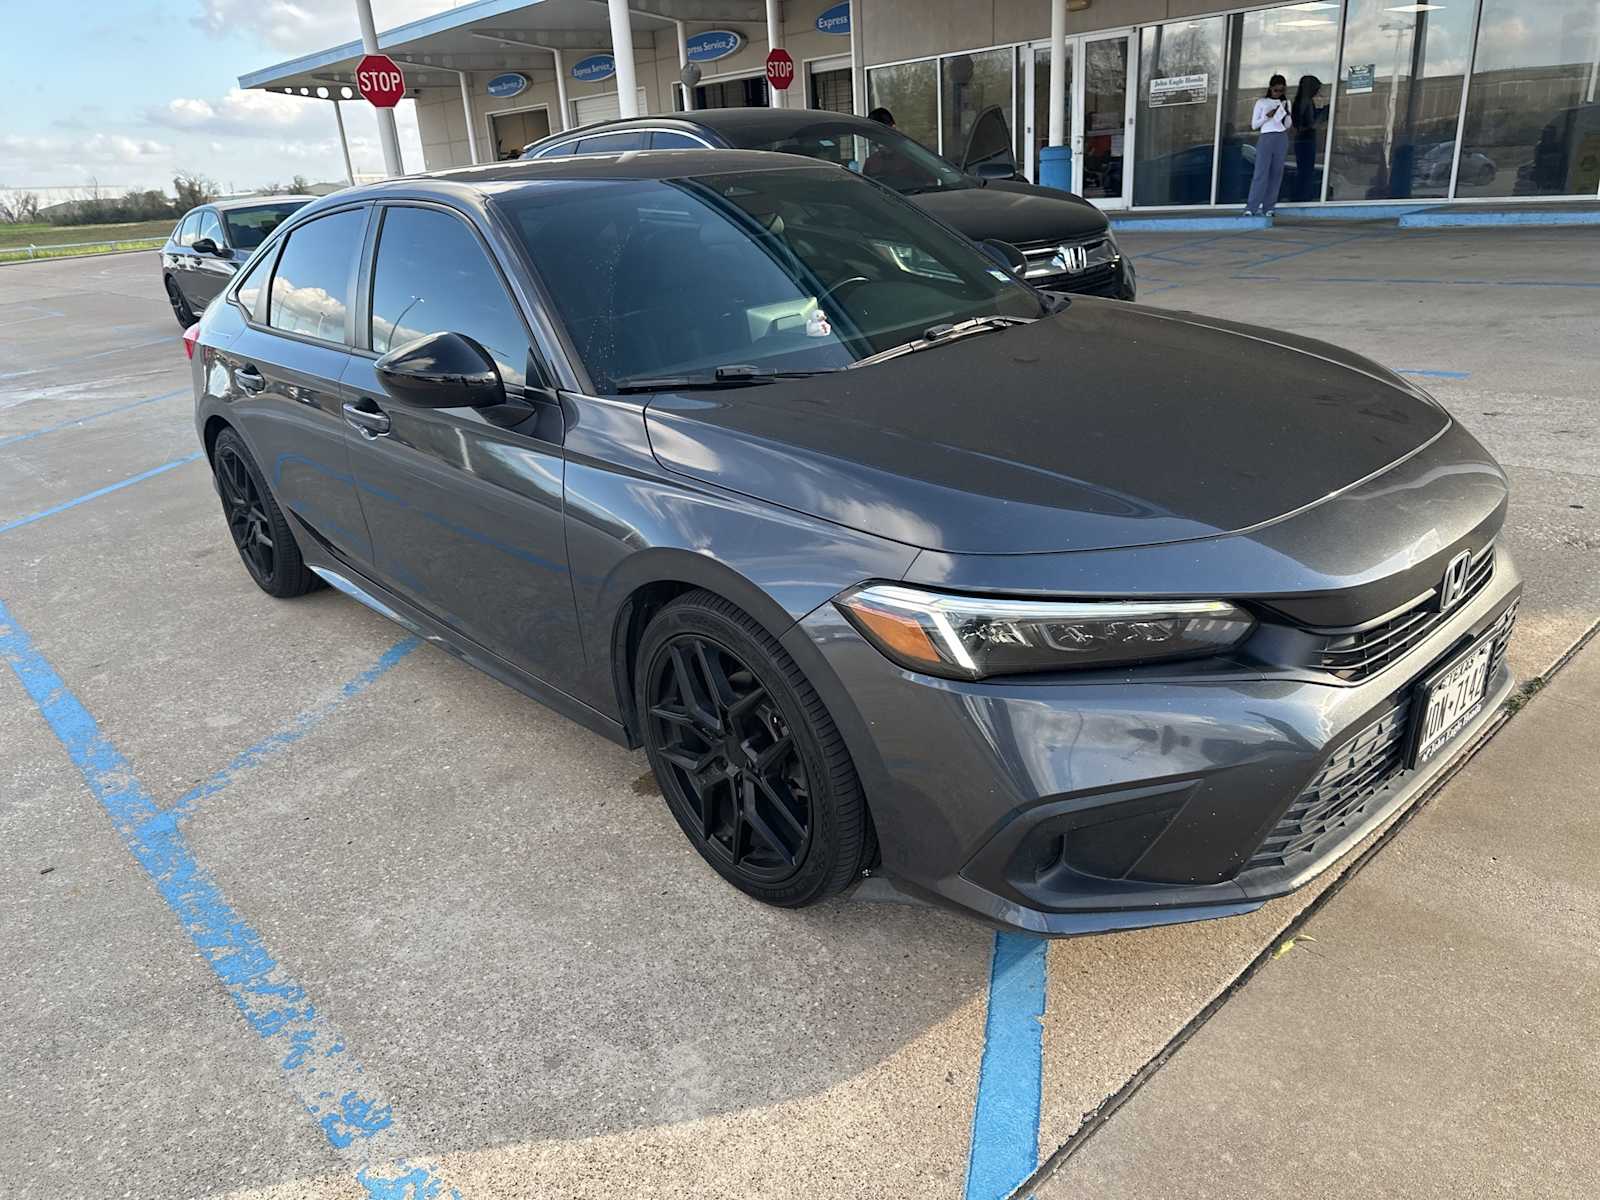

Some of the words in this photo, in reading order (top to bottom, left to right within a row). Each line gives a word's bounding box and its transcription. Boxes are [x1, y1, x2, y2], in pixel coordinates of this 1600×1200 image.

[818, 15, 848, 30] Express
[768, 61, 792, 78] STOP
[359, 71, 401, 92] STOP
